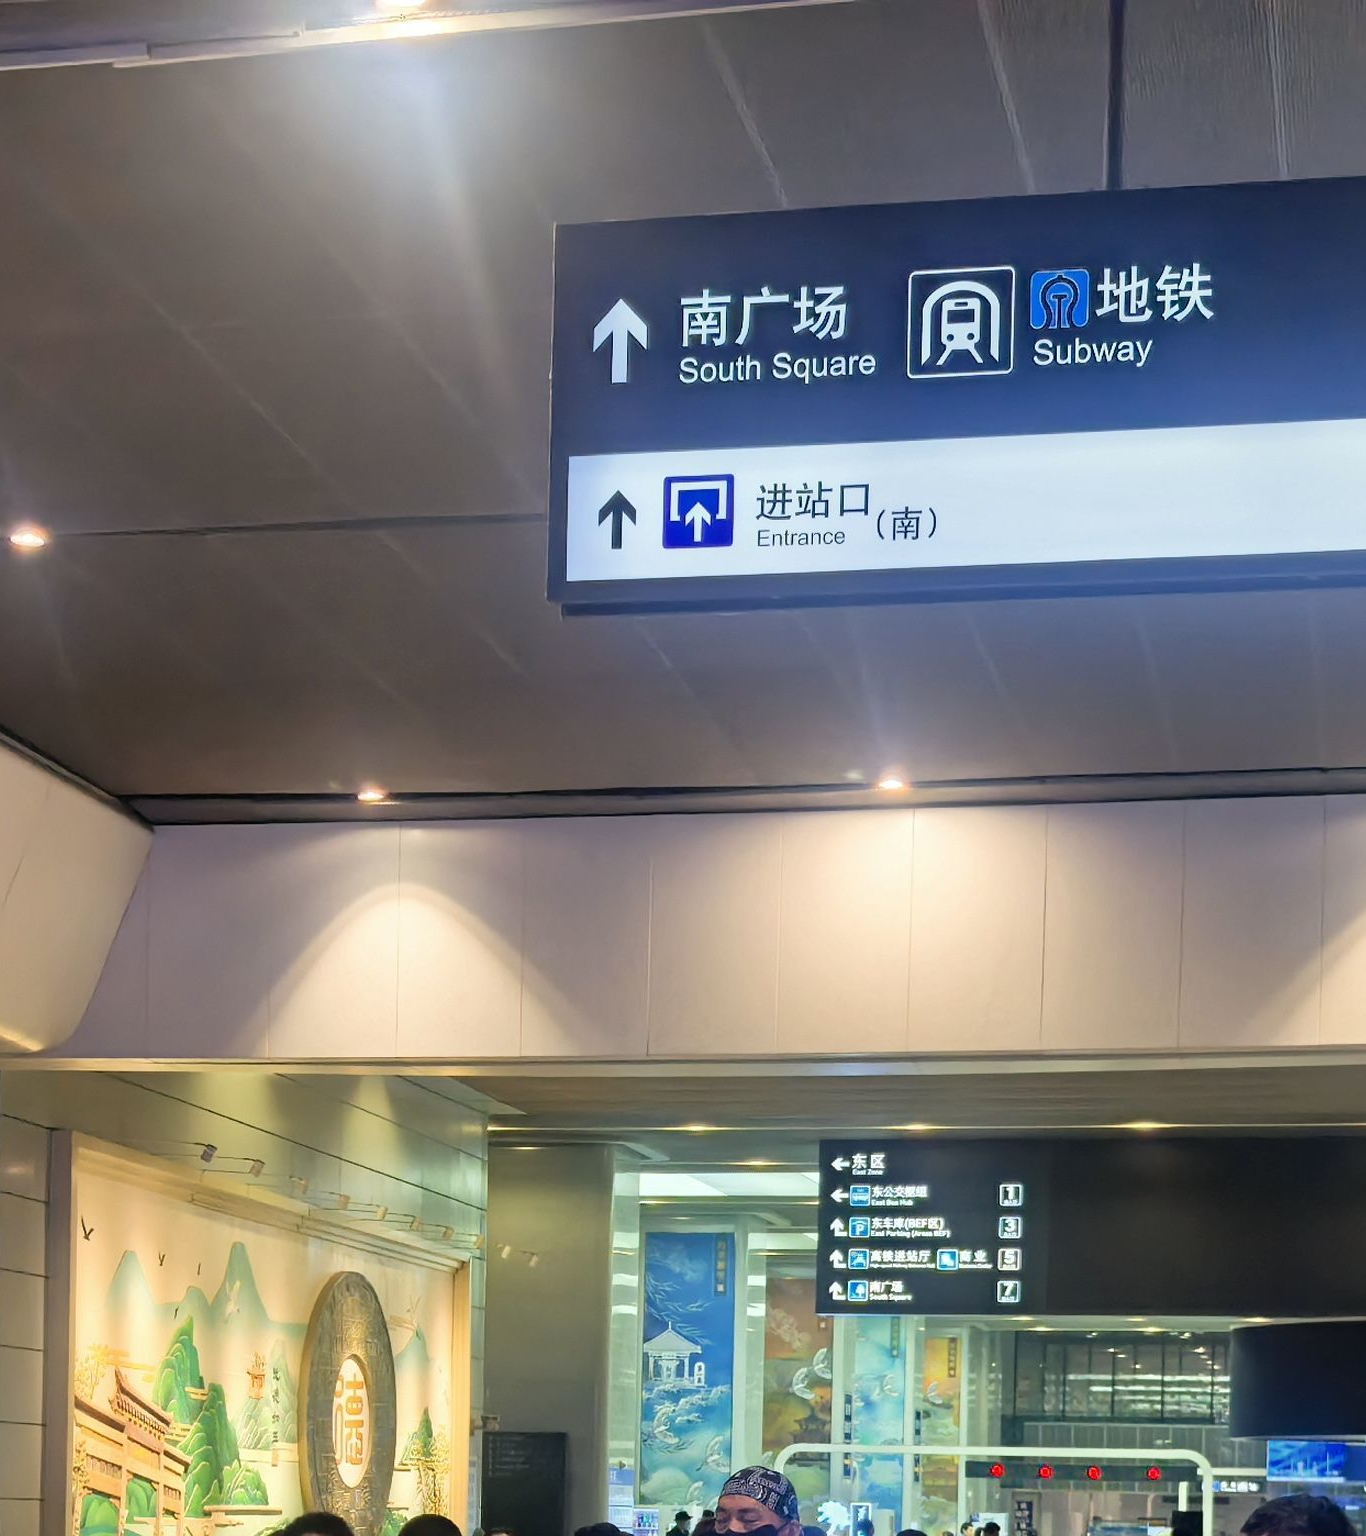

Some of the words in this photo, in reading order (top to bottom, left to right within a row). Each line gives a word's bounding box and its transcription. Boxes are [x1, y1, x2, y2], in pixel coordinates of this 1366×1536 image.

[1096, 263, 1214, 324] 地铁
[679, 285, 847, 349] 南广场
[678, 352, 764, 384] South
[771, 347, 877, 383] Square
[1033, 336, 1153, 369] Subway
[756, 481, 869, 521] 进站口
[757, 526, 846, 548] Entrance
